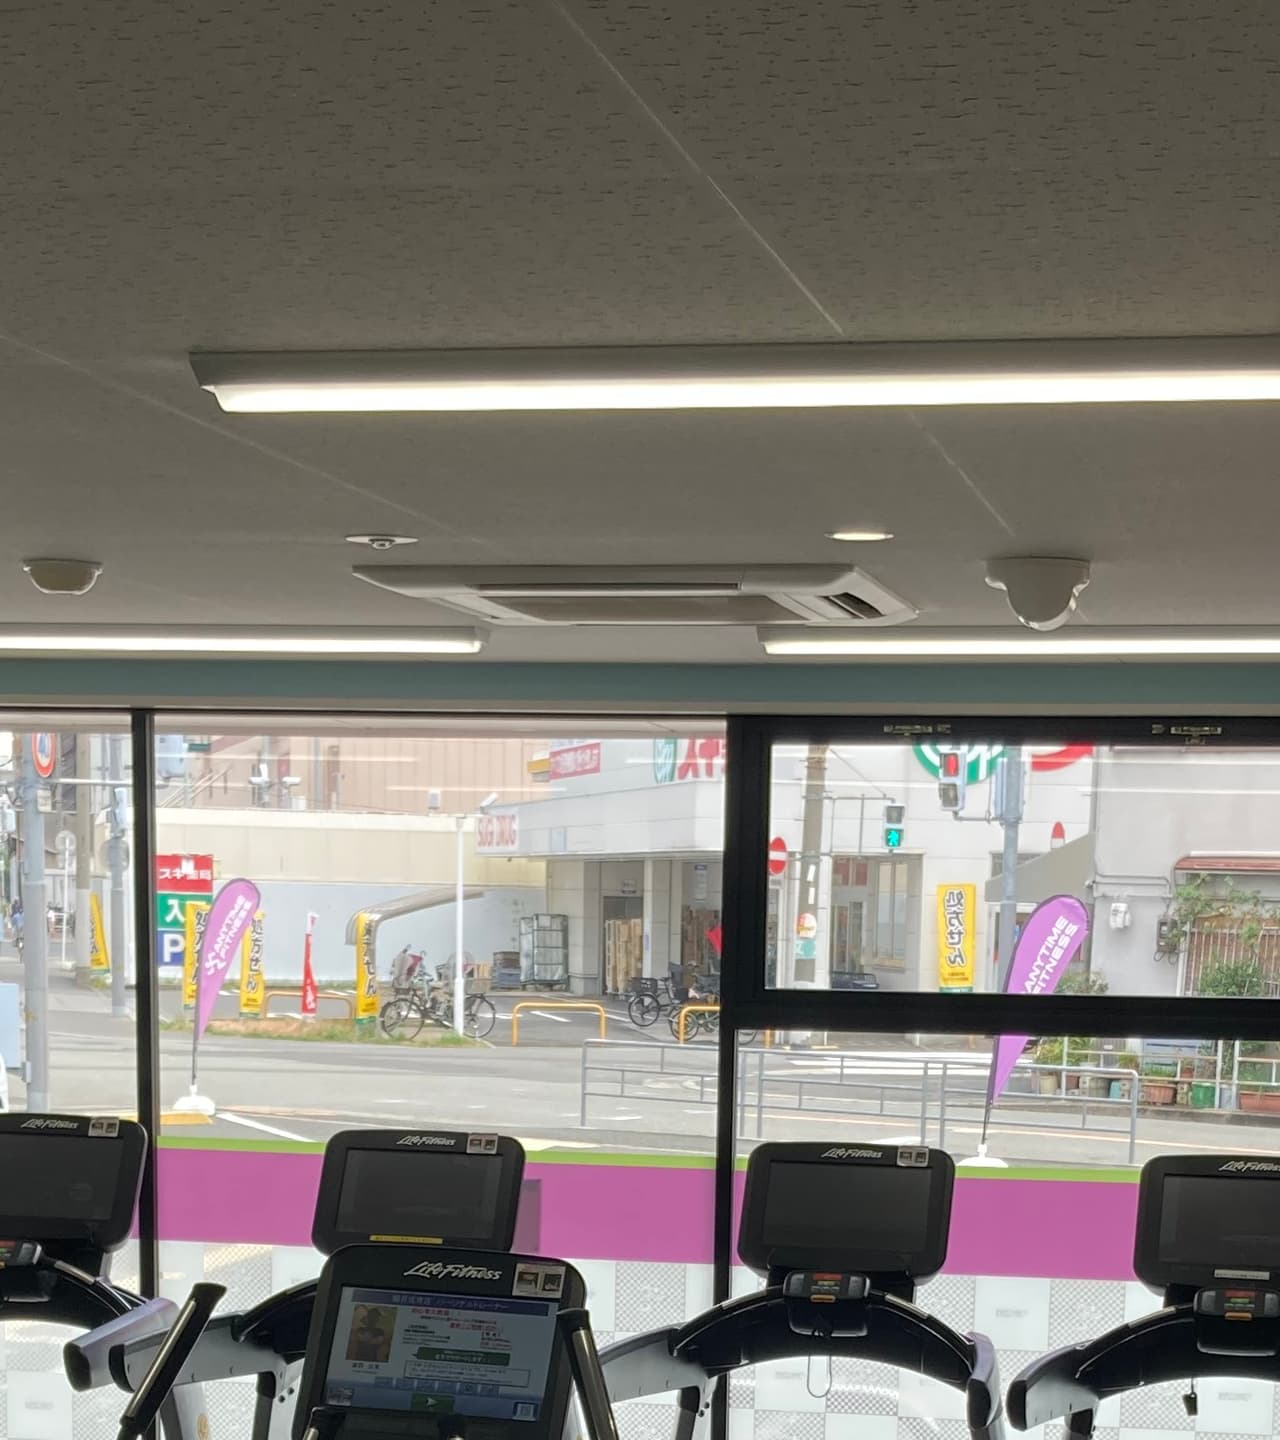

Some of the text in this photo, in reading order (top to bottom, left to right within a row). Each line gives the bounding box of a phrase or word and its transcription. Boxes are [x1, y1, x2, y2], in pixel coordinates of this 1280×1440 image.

[165, 899, 186, 923] 入
[163, 933, 186, 962] P
[1023, 916, 1070, 993] ANYTIME
[1031, 922, 1081, 994] FITNESS
